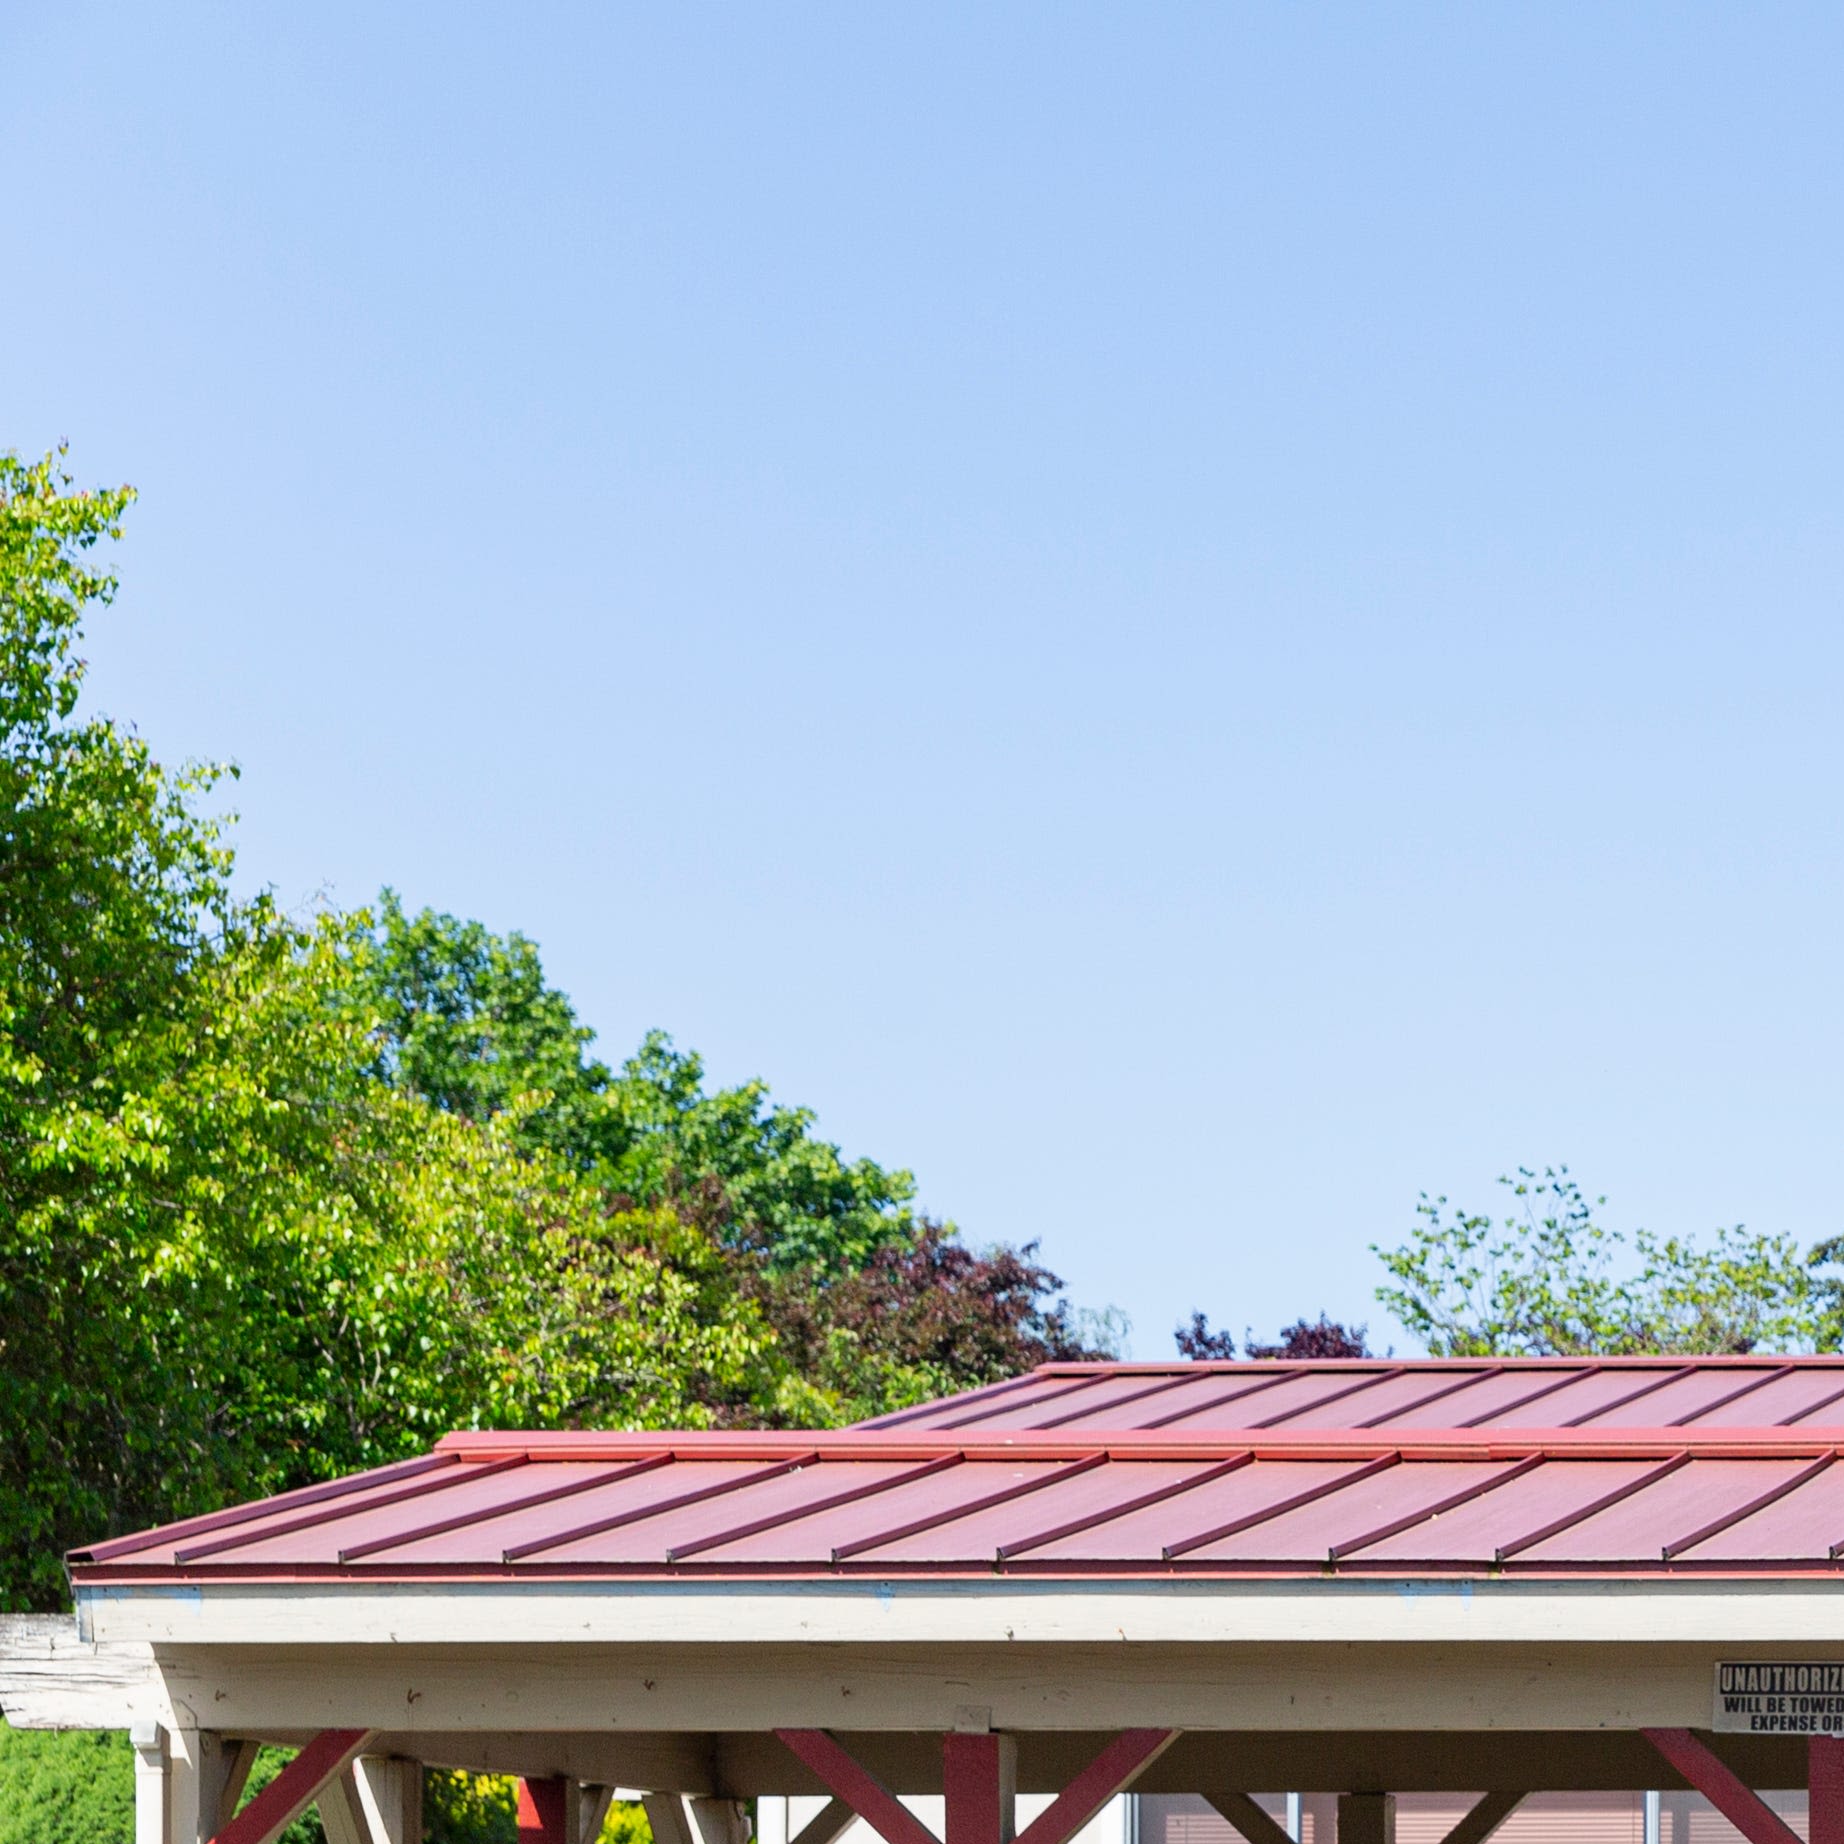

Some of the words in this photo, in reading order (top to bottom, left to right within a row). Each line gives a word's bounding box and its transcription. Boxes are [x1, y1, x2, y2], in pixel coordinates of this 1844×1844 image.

[1724, 1696, 1762, 1713] WILL
[1766, 1696, 1786, 1713] BE
[1750, 1714, 1818, 1731] EXPENSE
